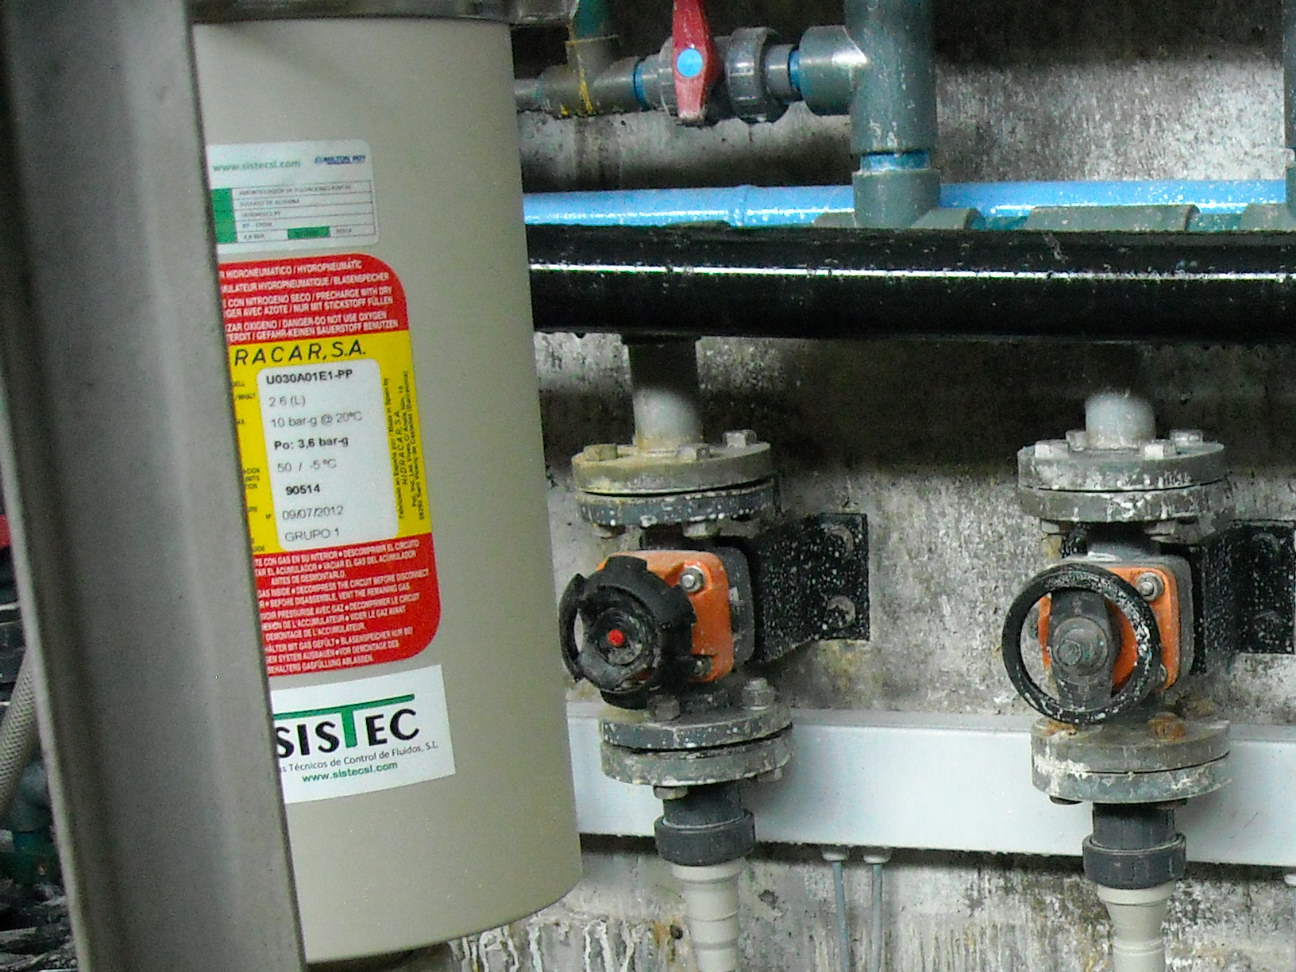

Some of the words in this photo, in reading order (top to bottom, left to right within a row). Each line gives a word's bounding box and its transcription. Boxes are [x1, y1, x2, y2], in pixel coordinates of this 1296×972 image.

[290, 293, 311, 303] SECO
[316, 288, 360, 301] PRECHARGE
[243, 307, 263, 317] AVEC
[264, 304, 288, 315] AZOTE
[266, 369, 353, 385] U030A01E1-PP
[271, 417, 285, 428] 10
[277, 462, 292, 472] 50
[285, 484, 320, 496] 90514
[282, 505, 344, 520] 09/07/2012
[284, 528, 331, 542] GRUPO
[334, 527, 340, 537] 1
[278, 555, 291, 565] GAS
[353, 557, 366, 567] GAS
[289, 760, 328, 773] Técnicos
[330, 757, 341, 767] de
[343, 752, 377, 765] Control
[379, 750, 390, 760] de
[425, 740, 439, 751] S.L.
[302, 762, 398, 783] www.sistecsl.com
